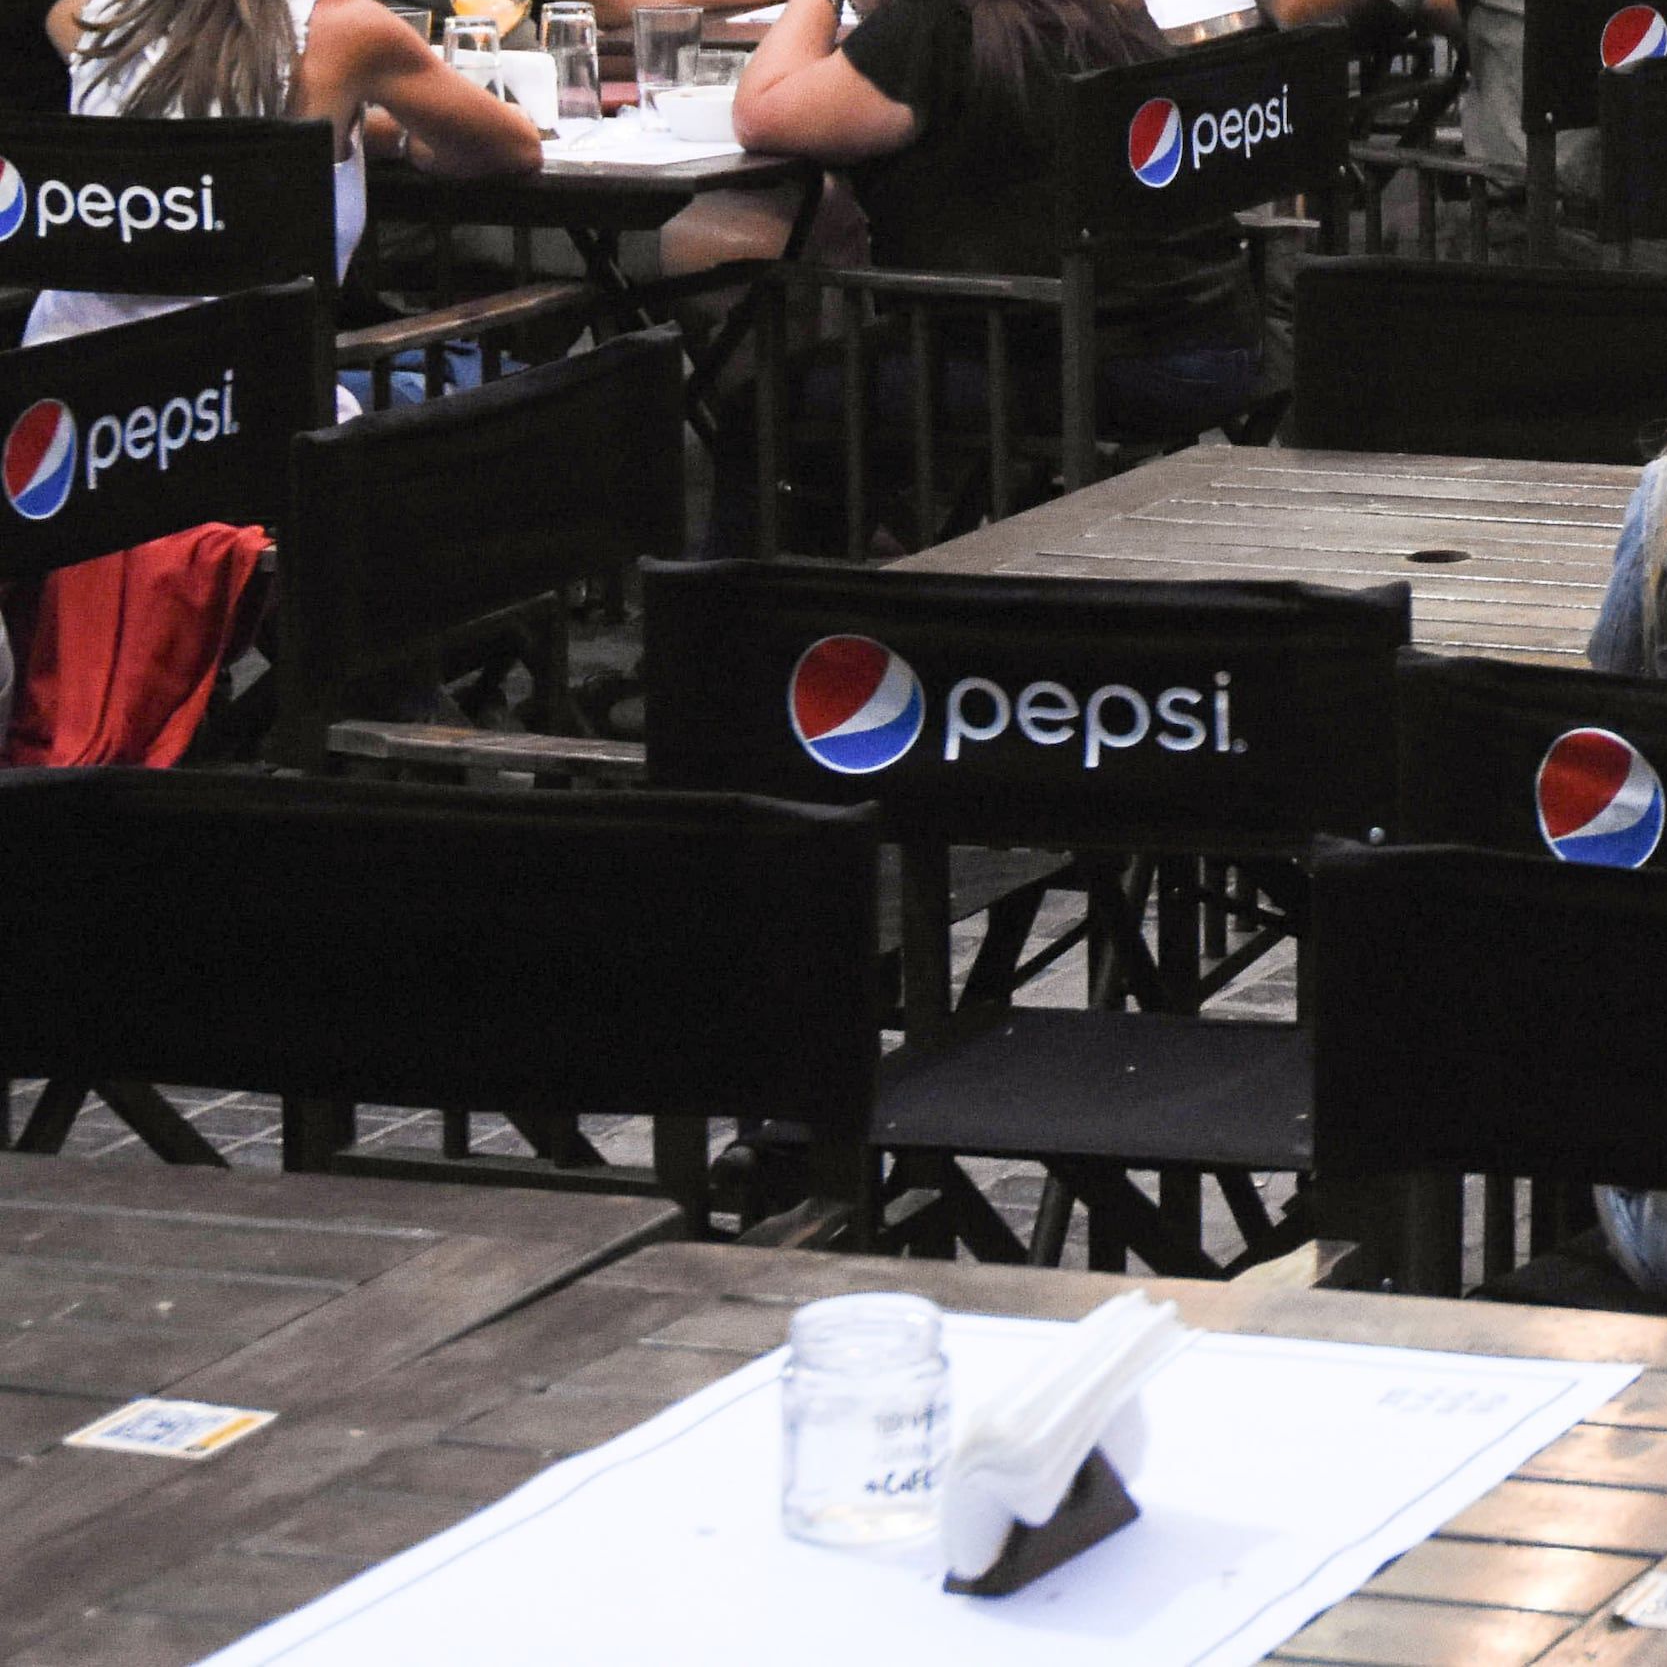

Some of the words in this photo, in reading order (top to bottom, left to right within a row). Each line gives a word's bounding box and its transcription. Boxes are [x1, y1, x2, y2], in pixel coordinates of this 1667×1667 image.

[1191, 83, 1292, 170] pepsi
[37, 174, 222, 244] pepsi
[87, 368, 237, 491] pepsi
[943, 670, 1240, 770] pepsi
